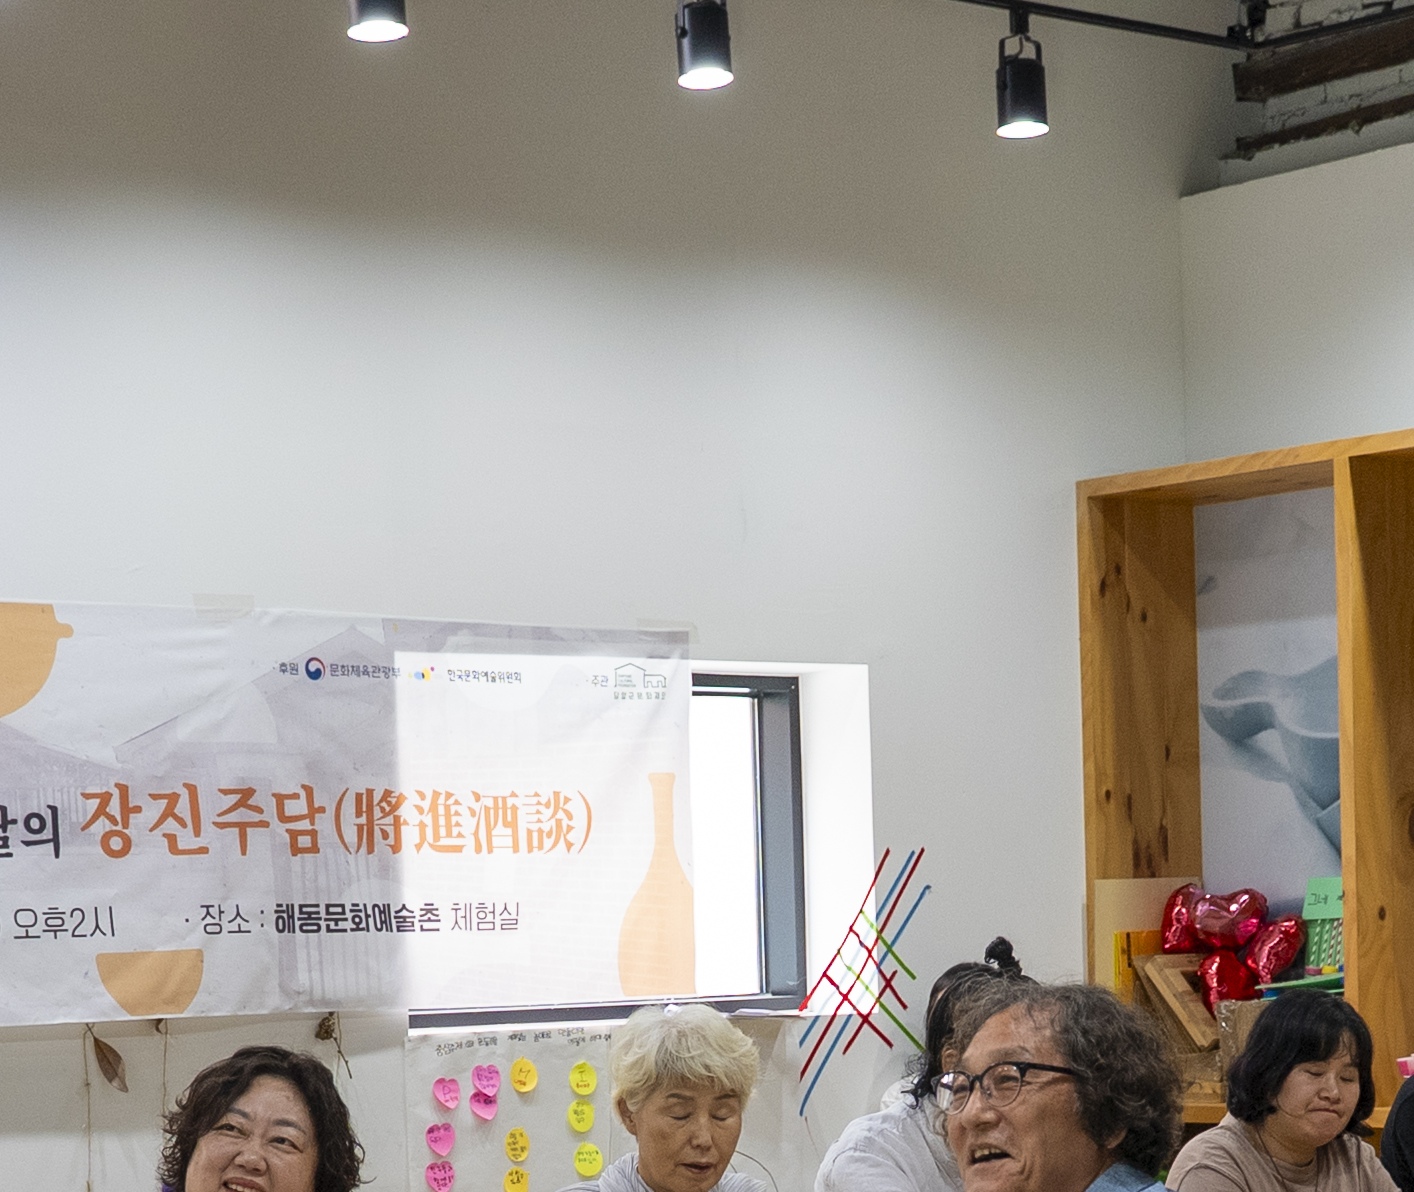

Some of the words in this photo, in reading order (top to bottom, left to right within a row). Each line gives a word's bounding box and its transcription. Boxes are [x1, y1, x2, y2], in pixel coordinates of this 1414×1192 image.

[329, 663, 402, 680] 문화체육관광부
[79, 781, 594, 860] 장진주담(將進酒談)
[11, 903, 117, 941] 오후2시
[199, 903, 251, 936] 장소
[273, 901, 443, 935] 해동문화예술촌
[449, 901, 522, 933] 체험실
